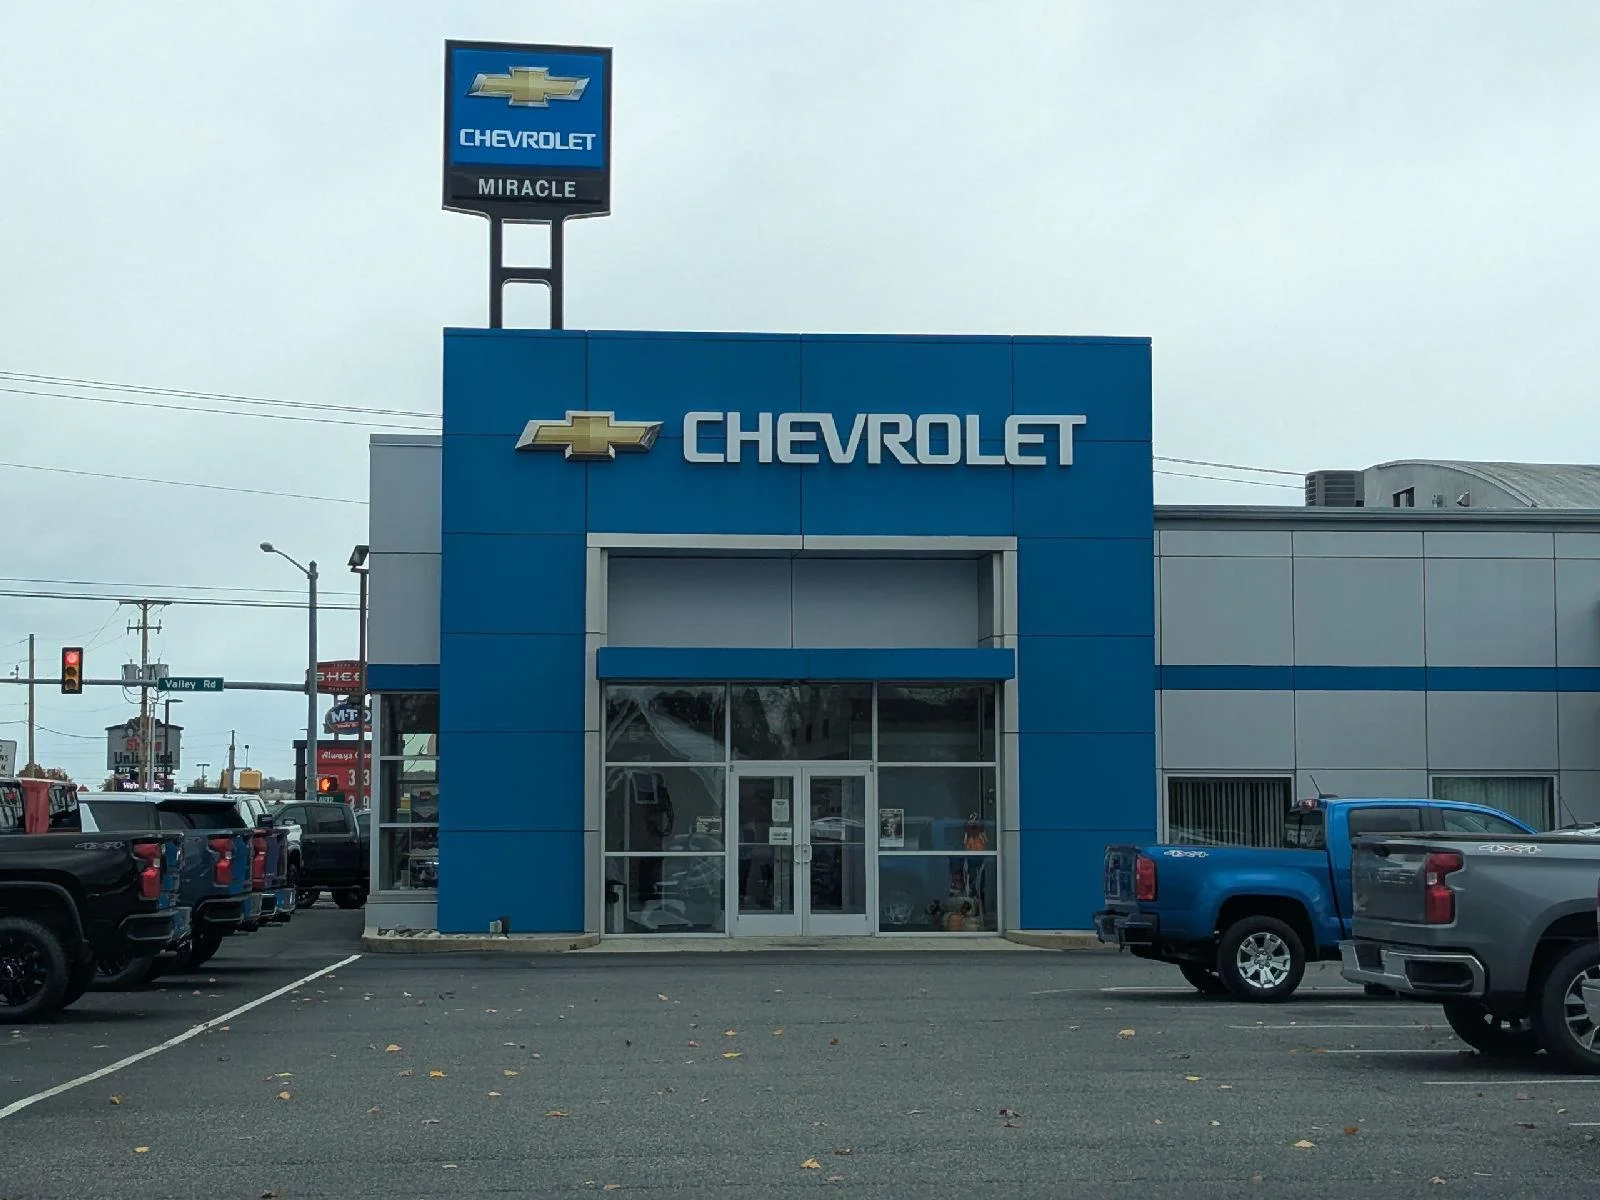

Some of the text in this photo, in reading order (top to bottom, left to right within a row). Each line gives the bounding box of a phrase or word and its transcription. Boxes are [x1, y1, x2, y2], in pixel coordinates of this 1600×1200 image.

[459, 128, 597, 151] CHEVROLET
[478, 178, 577, 198] MIRACLE
[683, 411, 1087, 466] CHEVROLET
[165, 679, 217, 690] Valley Rd
[321, 751, 353, 761] Always
